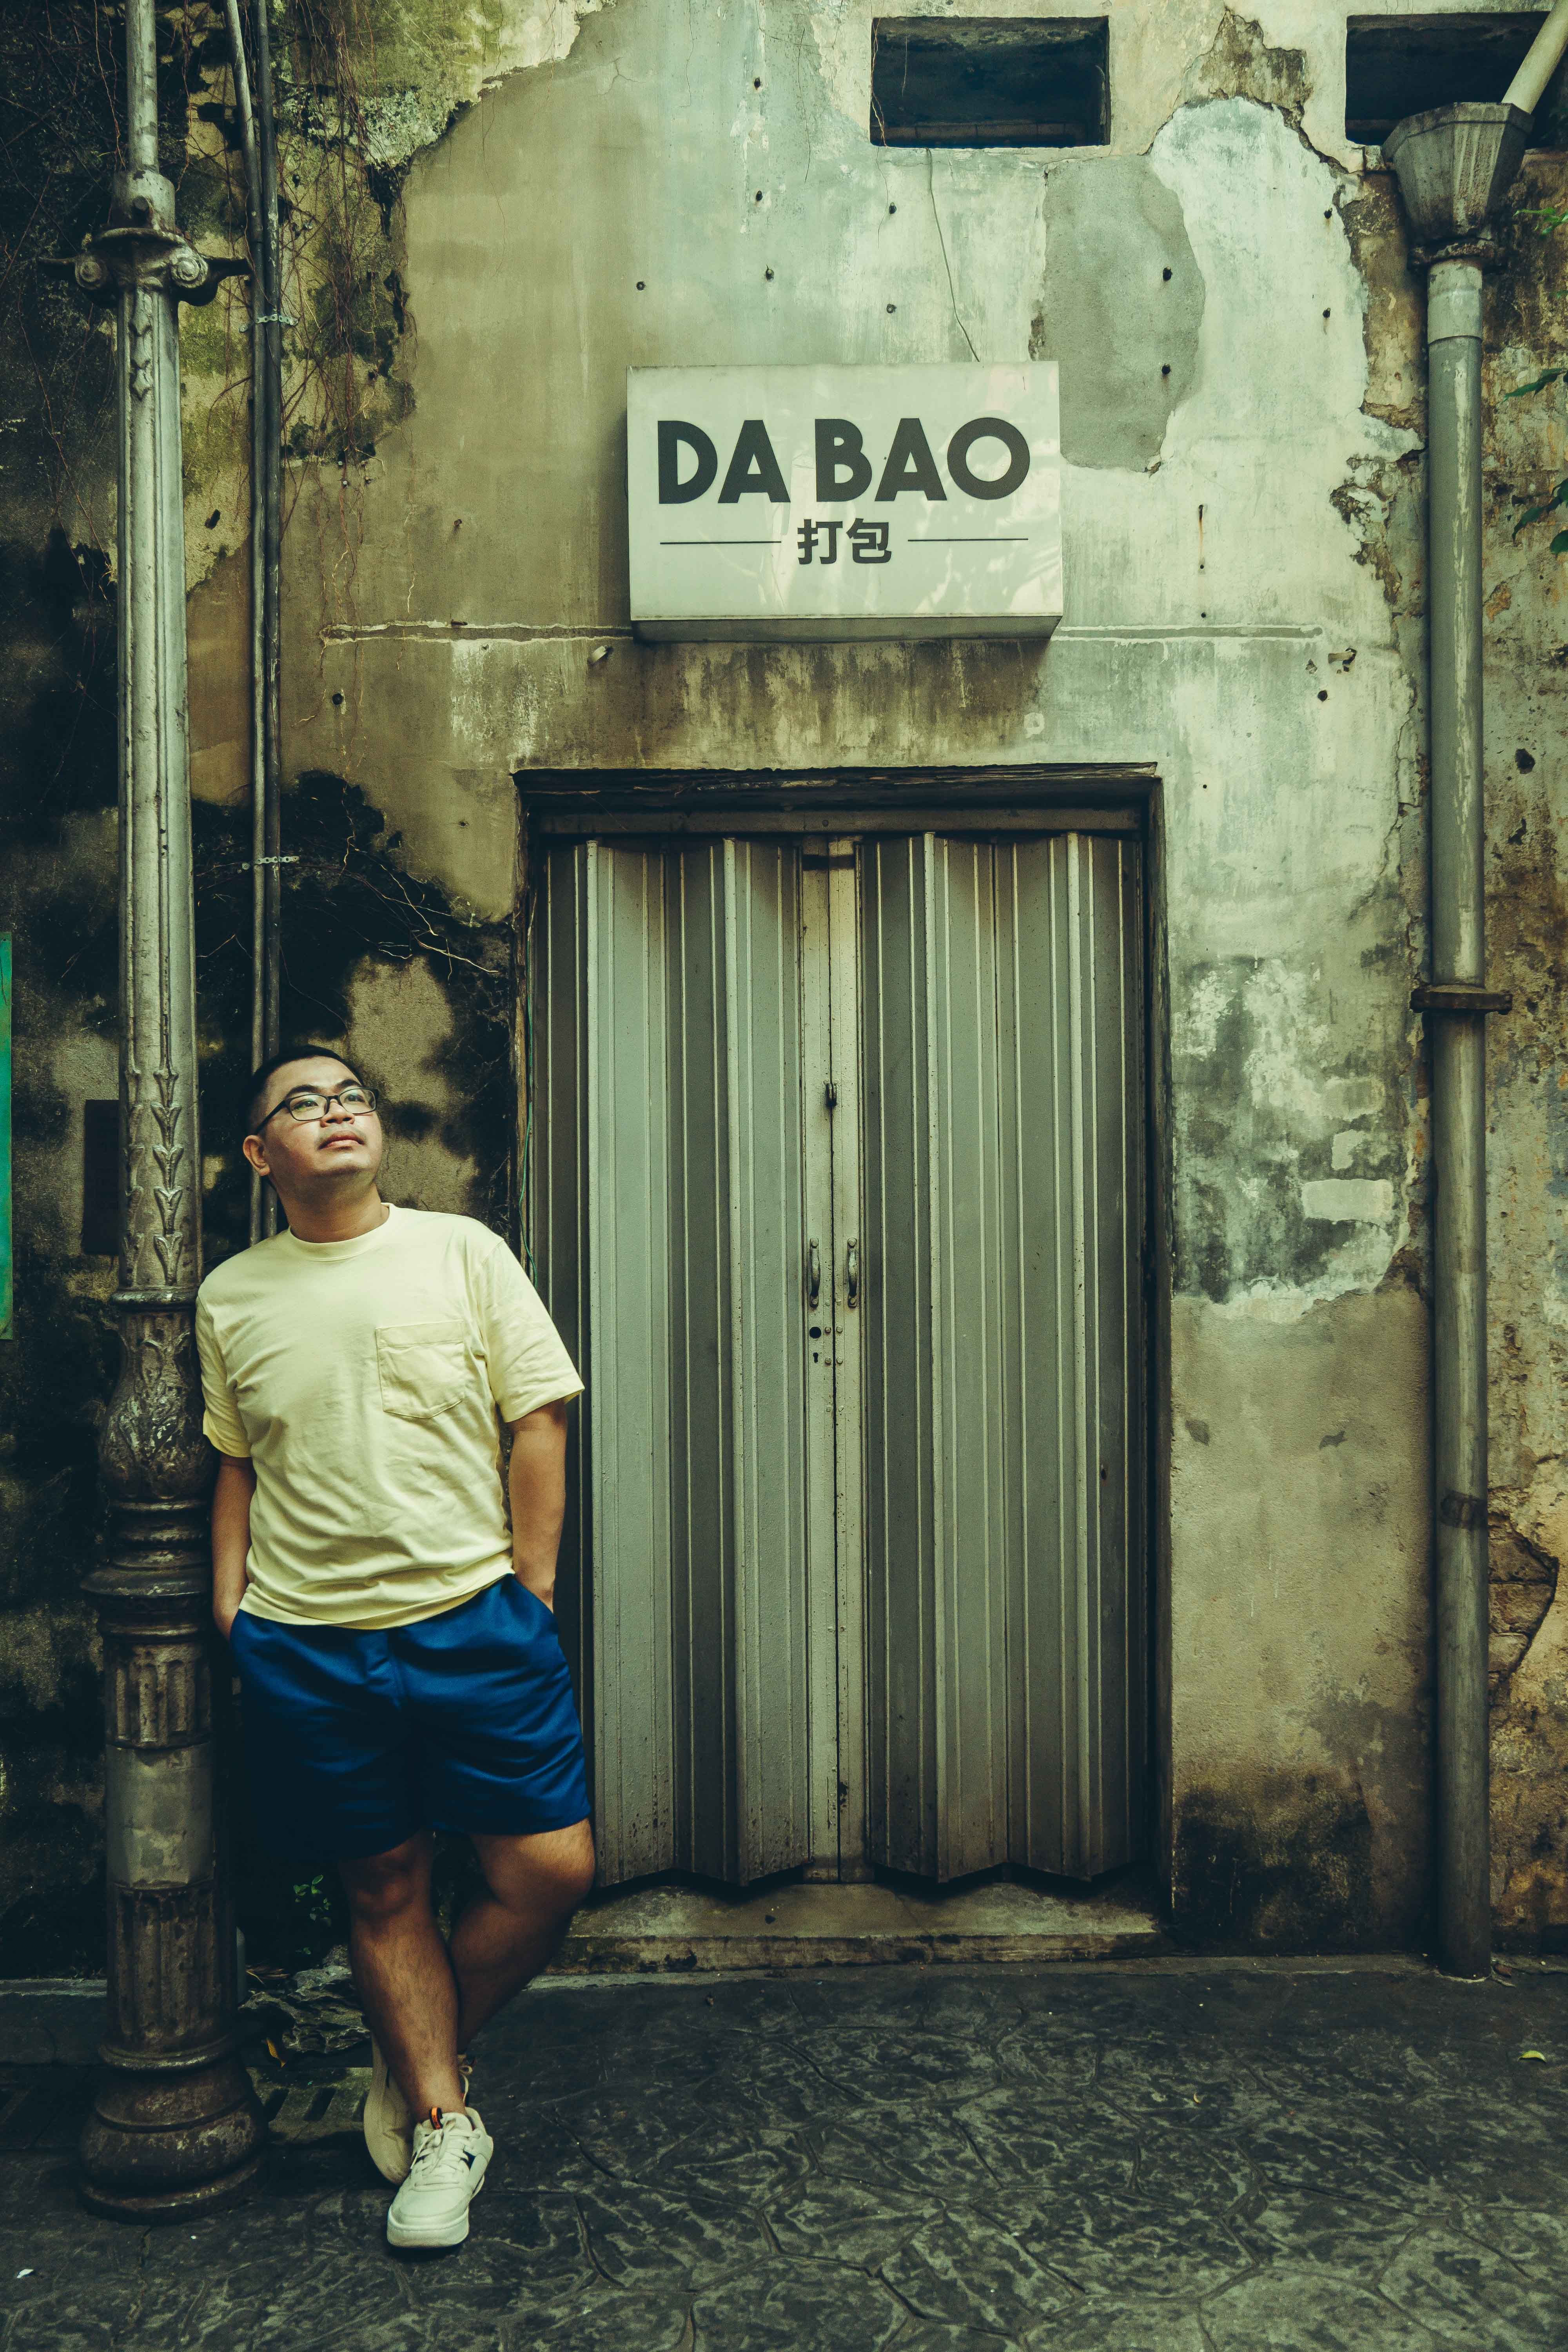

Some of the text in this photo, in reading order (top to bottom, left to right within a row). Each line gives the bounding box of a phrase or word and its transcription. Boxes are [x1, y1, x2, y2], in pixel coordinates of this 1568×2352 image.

[657, 417, 1030, 504] DA BAO
[797, 518, 892, 565] 打包
